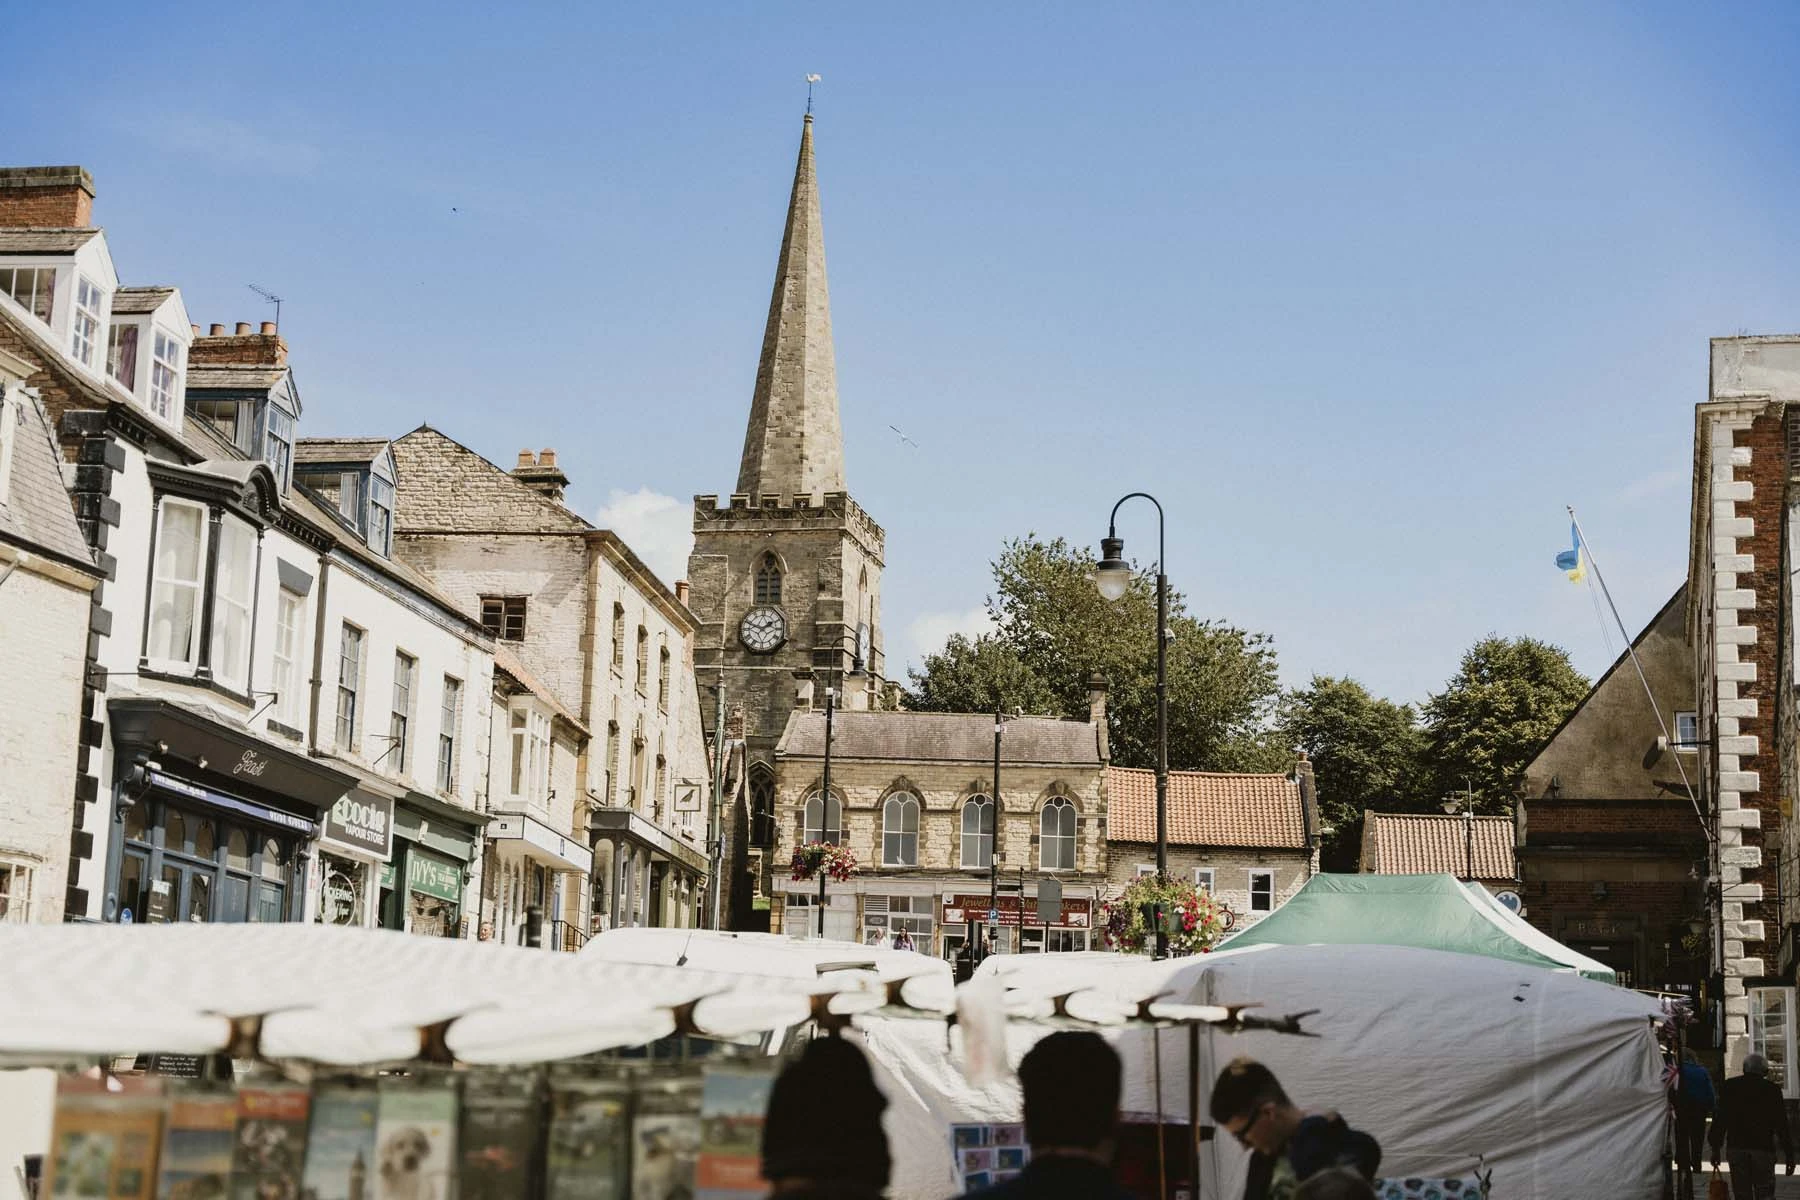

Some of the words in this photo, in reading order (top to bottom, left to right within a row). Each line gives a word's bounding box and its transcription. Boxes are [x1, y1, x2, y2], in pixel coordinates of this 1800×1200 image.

[233, 750, 268, 776] Feast
[345, 823, 367, 840] VAPOUR
[367, 830, 385, 846] STORE
[412, 860, 437, 887] IVY'S
[960, 897, 1004, 908] Jewellrs
[990, 911, 997, 919] P
